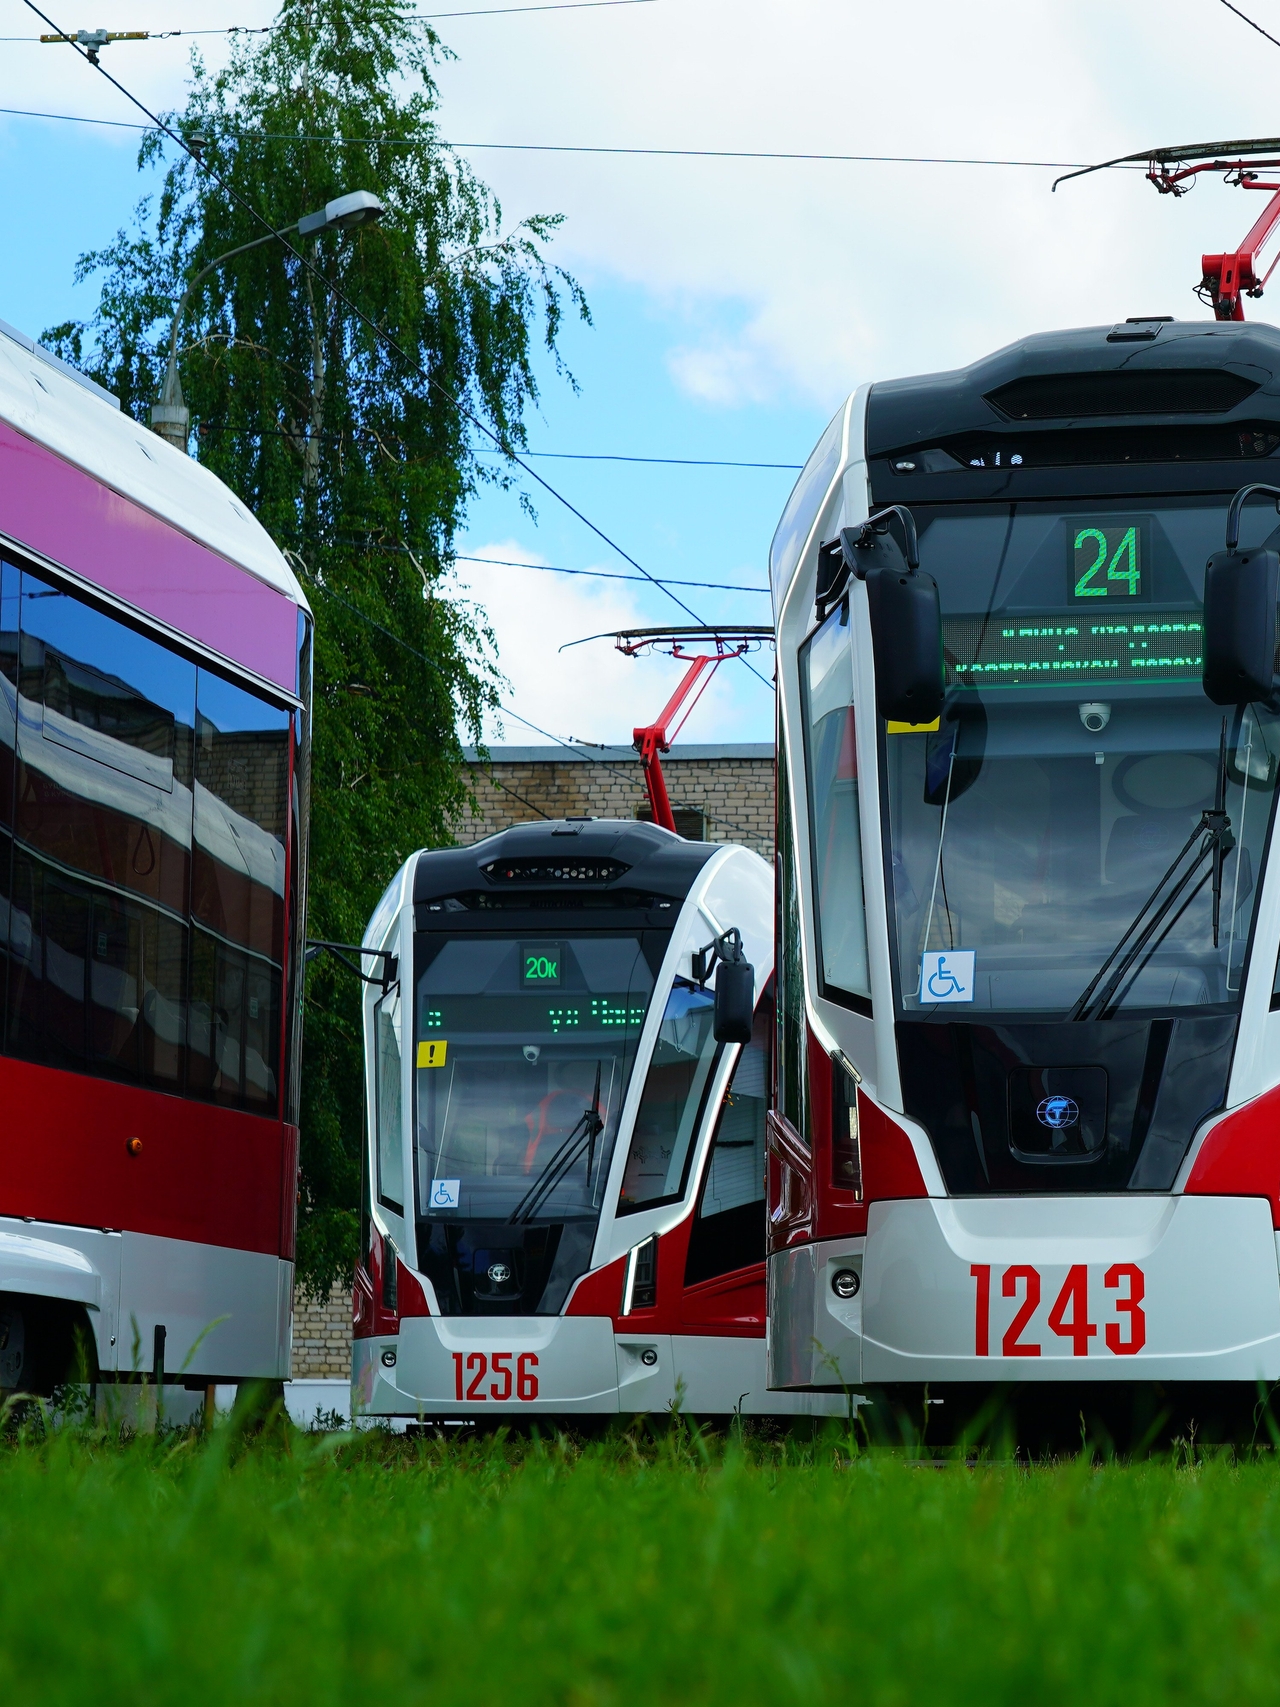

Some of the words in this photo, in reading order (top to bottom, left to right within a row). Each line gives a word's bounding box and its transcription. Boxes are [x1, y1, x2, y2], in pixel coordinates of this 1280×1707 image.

[1074, 527, 1140, 597] 24
[970, 1263, 1146, 1357] 1243
[452, 1352, 539, 1401] 1256
